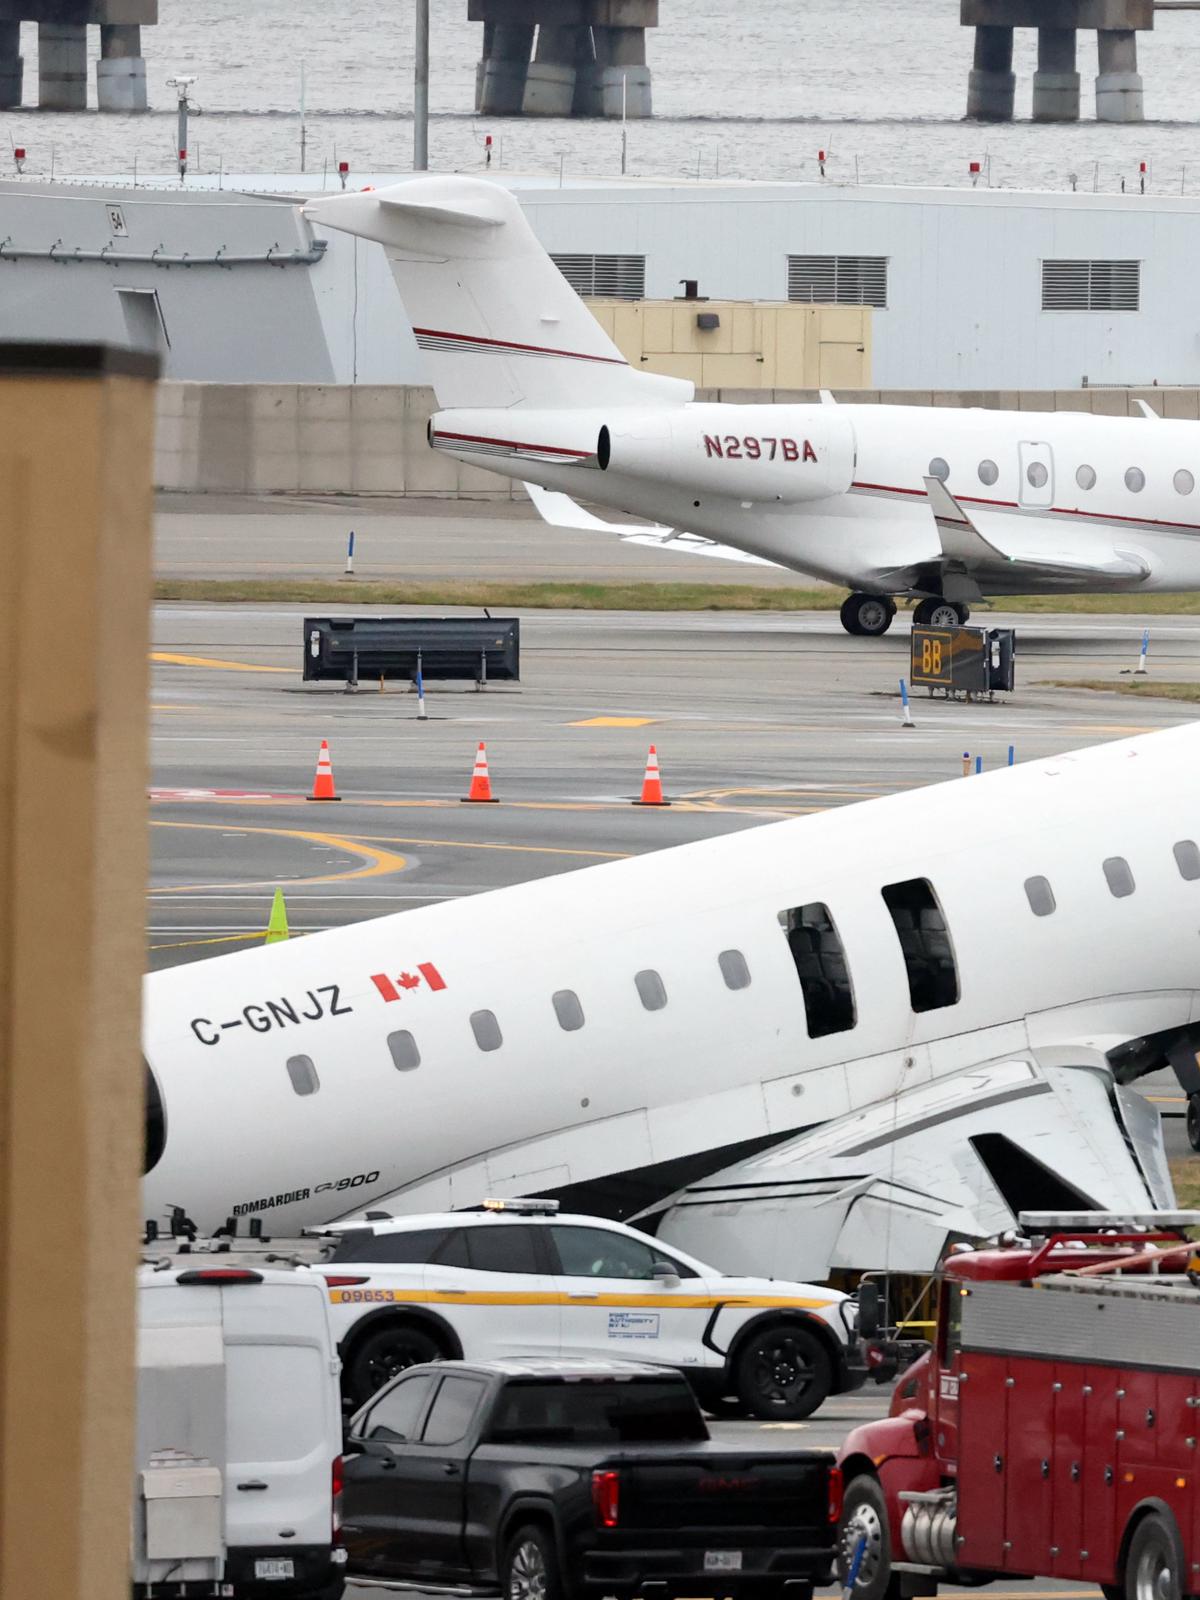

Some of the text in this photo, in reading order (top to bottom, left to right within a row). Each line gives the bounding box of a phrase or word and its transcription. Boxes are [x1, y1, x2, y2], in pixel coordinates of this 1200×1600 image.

[703, 434, 819, 463] N297BA
[190, 984, 353, 1046] C-GNJZ
[233, 1188, 310, 1217] BOMBARDIER
